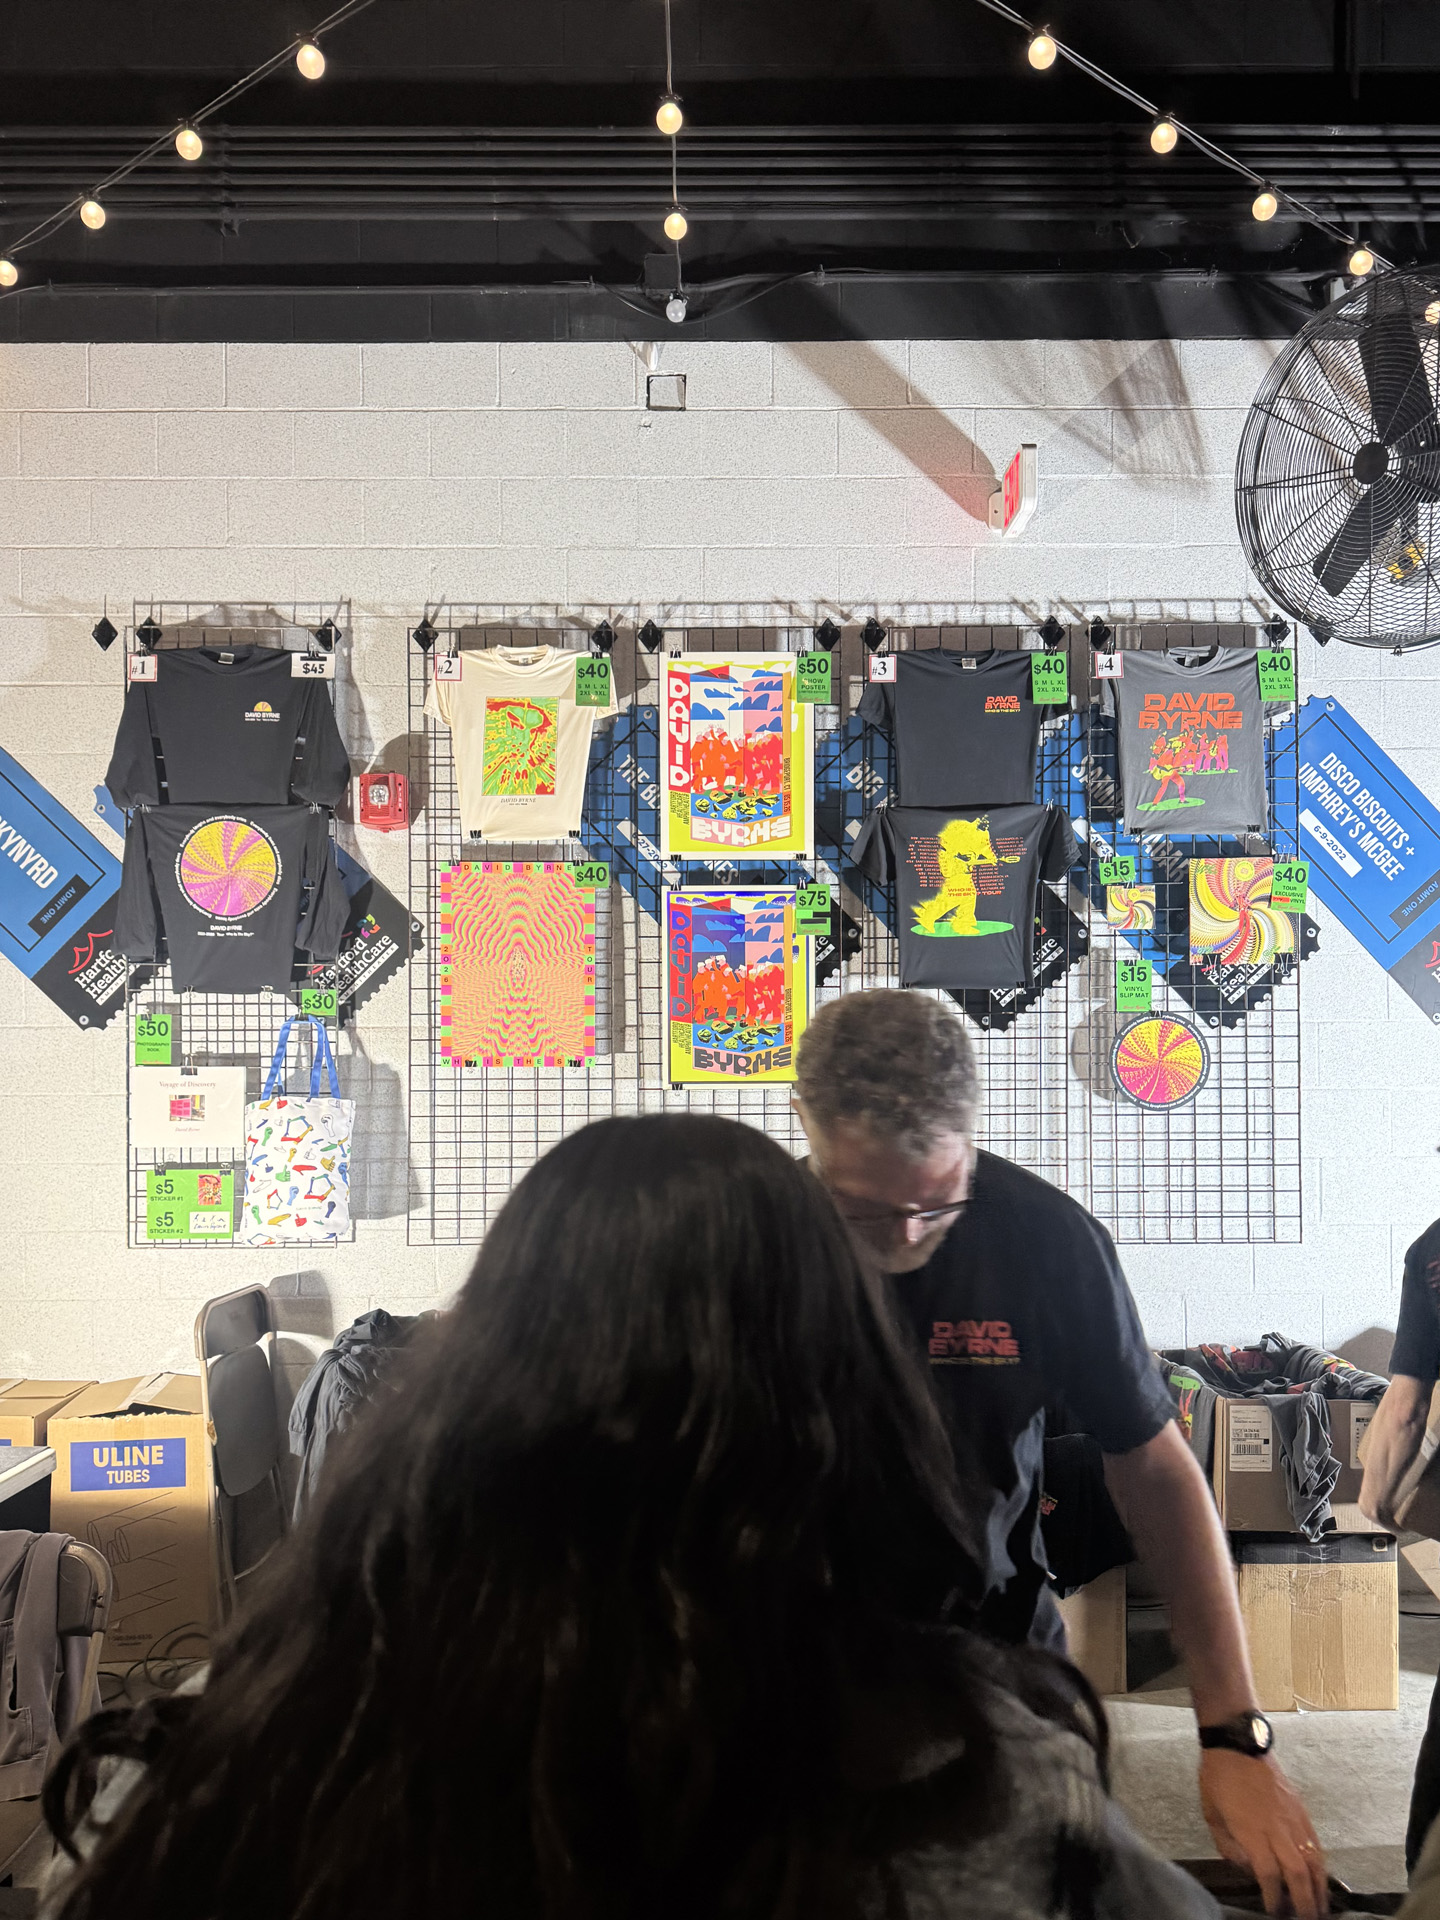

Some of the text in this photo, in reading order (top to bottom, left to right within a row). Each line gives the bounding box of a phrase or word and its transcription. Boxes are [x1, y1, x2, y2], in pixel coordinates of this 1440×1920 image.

[132, 661, 147, 675] #1
[303, 663, 325, 674] $45
[437, 660, 453, 674] #2
[578, 663, 608, 678] $40
[799, 658, 828, 674] $50
[872, 661, 887, 675] #3
[1034, 659, 1064, 674] $40
[1098, 657, 1114, 672] #4
[1260, 656, 1291, 672] $40
[1145, 692, 1235, 712] DAVID
[1139, 711, 1243, 729] BYRNE
[845, 757, 885, 799] BIG
[1072, 755, 1124, 825] SAMM
[1319, 752, 1360, 795] DISCO
[1352, 788, 1409, 850] BISCUITS
[1298, 762, 1405, 881] UMPHREY'S MCGEE
[692, 815, 791, 847] BYRNE
[1313, 825, 1347, 861] 6-9-2022
[0, 815, 58, 889] KYNYRD
[577, 867, 607, 883] $40
[1104, 860, 1130, 877] $15
[1275, 867, 1306, 883] $40
[40, 886, 76, 924] ADMIT ONE
[799, 891, 827, 906] $75
[1401, 880, 1439, 917] ADMIT ONE
[74, 949, 114, 989] Hartf
[329, 934, 393, 995] ealthCare
[85, 954, 127, 1000] Health
[1121, 967, 1147, 982] $15
[304, 994, 335, 1010] $30
[138, 1021, 169, 1037] $50
[694, 1046, 791, 1076] BYRNE
[155, 1179, 174, 1195] $5
[155, 1212, 174, 1227] $5
[932, 1319, 1012, 1338] DAVID
[928, 1337, 1020, 1356] BYRNE
[93, 1445, 164, 1468] ULINE
[107, 1469, 150, 1484] TUBES
